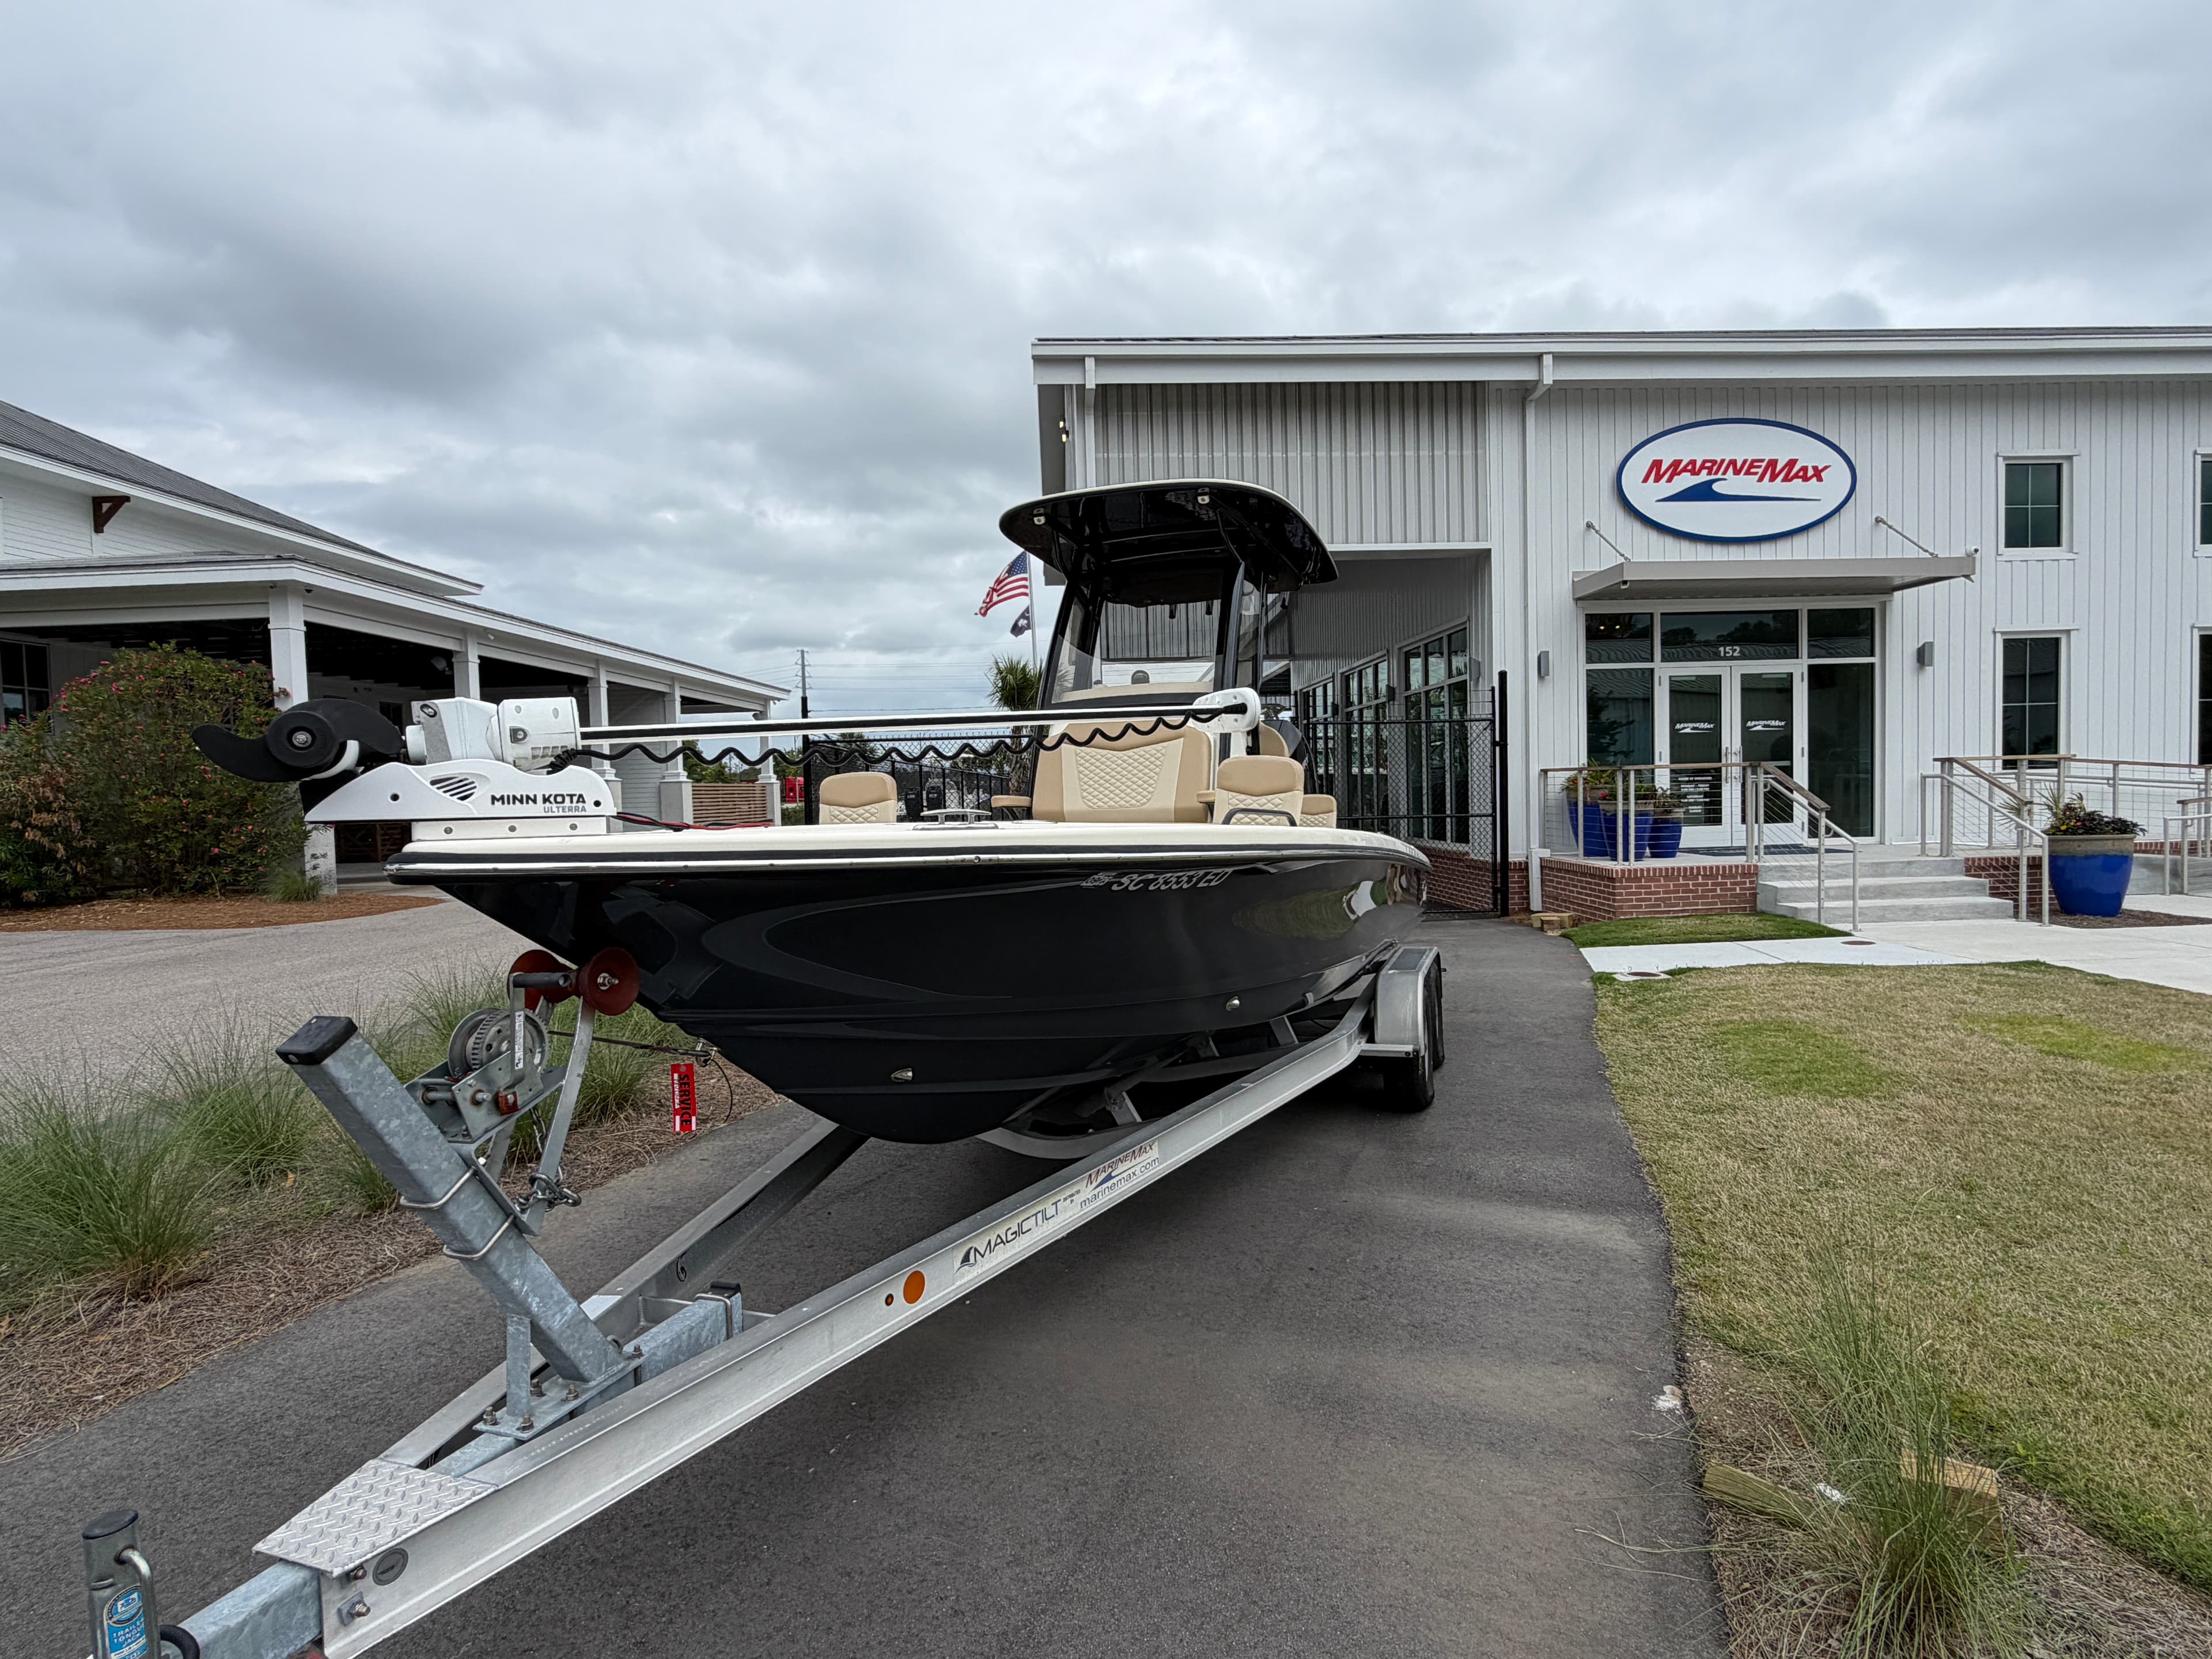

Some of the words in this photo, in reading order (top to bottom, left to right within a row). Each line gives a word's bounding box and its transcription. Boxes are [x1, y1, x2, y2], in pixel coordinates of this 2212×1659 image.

[1718, 646, 1741, 657] 152
[491, 794, 537, 805] MINN
[543, 793, 586, 804] KOTA
[543, 805, 587, 813] ULTERRA
[1112, 874, 1154, 891] SC
[1148, 870, 1202, 891] 8553
[1196, 869, 1233, 888] ED
[679, 1073, 692, 1126] SERVICE
[1080, 1157, 1160, 1209] marinemax.com
[974, 1199, 1061, 1263] MAGICTILT
[122, 1633, 141, 1647] JACK
